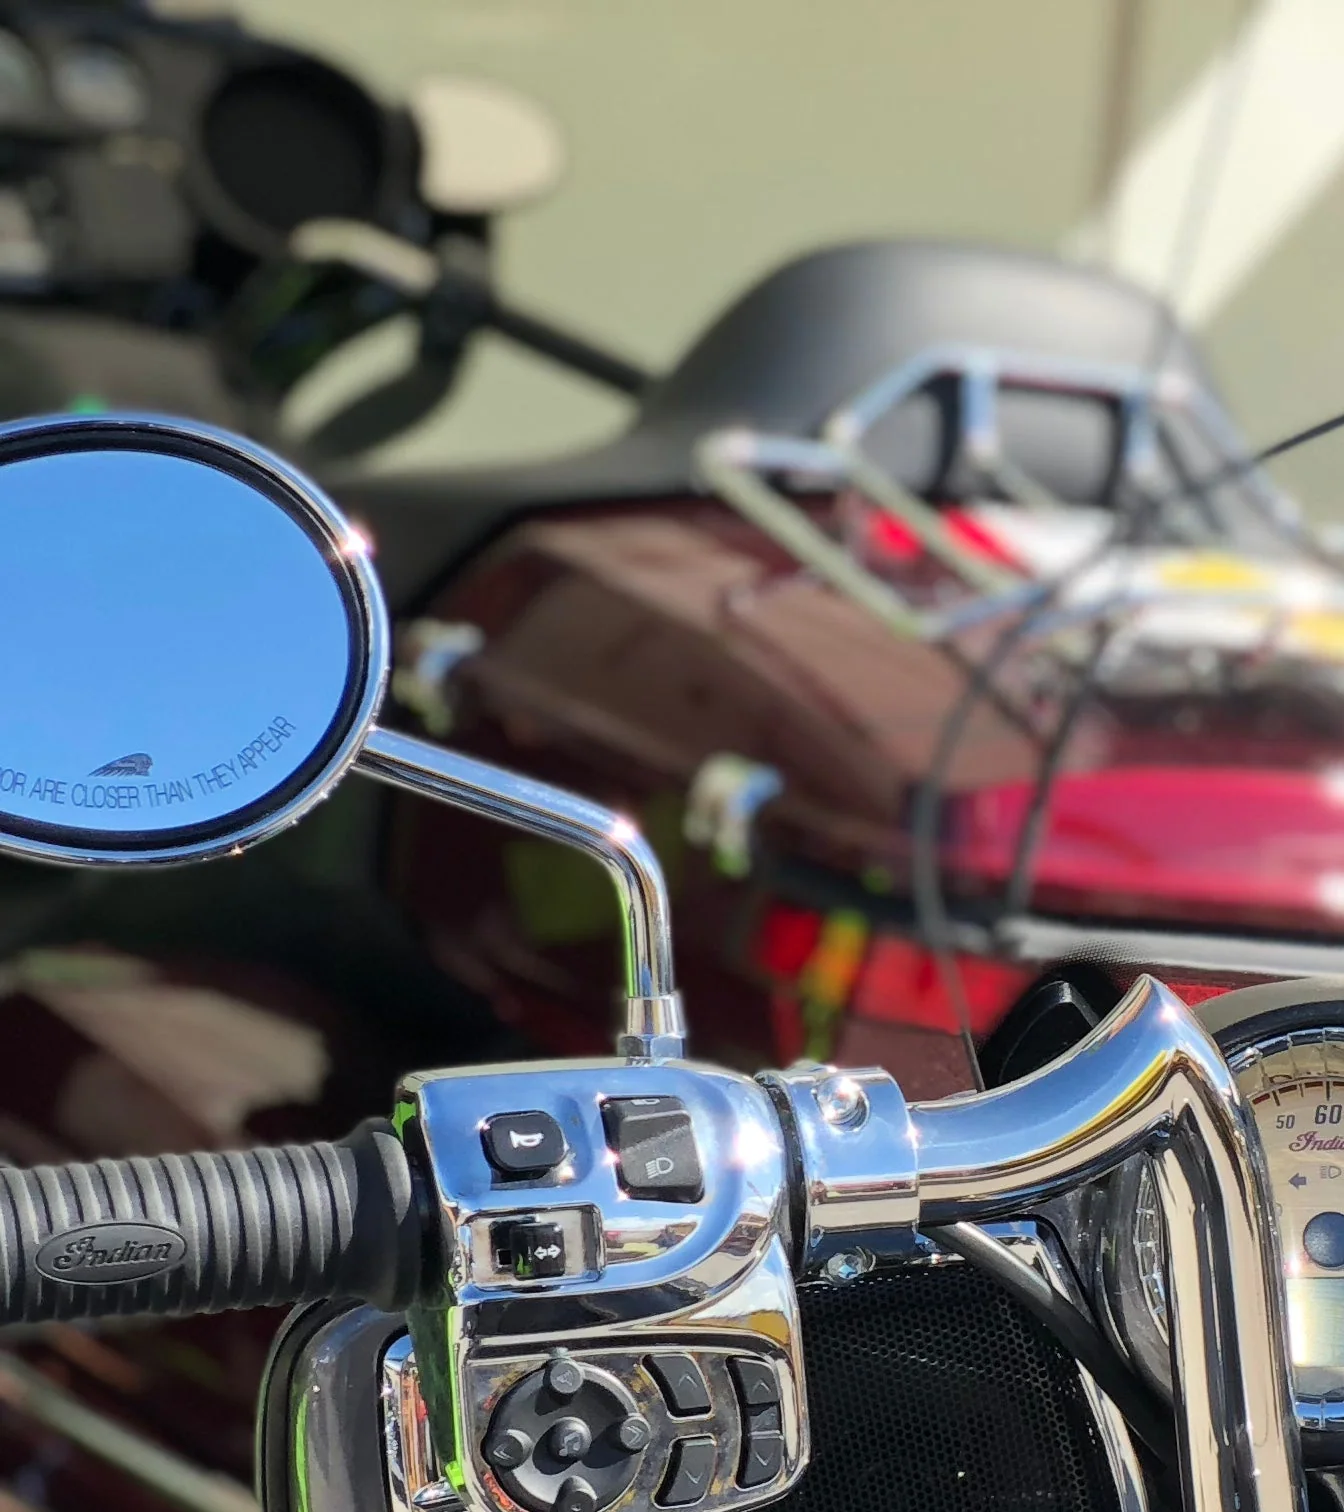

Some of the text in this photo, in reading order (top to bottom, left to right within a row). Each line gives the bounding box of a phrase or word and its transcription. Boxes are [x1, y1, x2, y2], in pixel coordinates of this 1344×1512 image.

[29, 776, 69, 805] ARE
[71, 783, 140, 809] CLOSER
[143, 778, 194, 808] THAN
[191, 759, 240, 796] THEY
[236, 715, 297, 776] APPEAR
[1276, 1114, 1296, 1130] 50
[1314, 1104, 1343, 1125] 60
[53, 1234, 172, 1271] Indian
